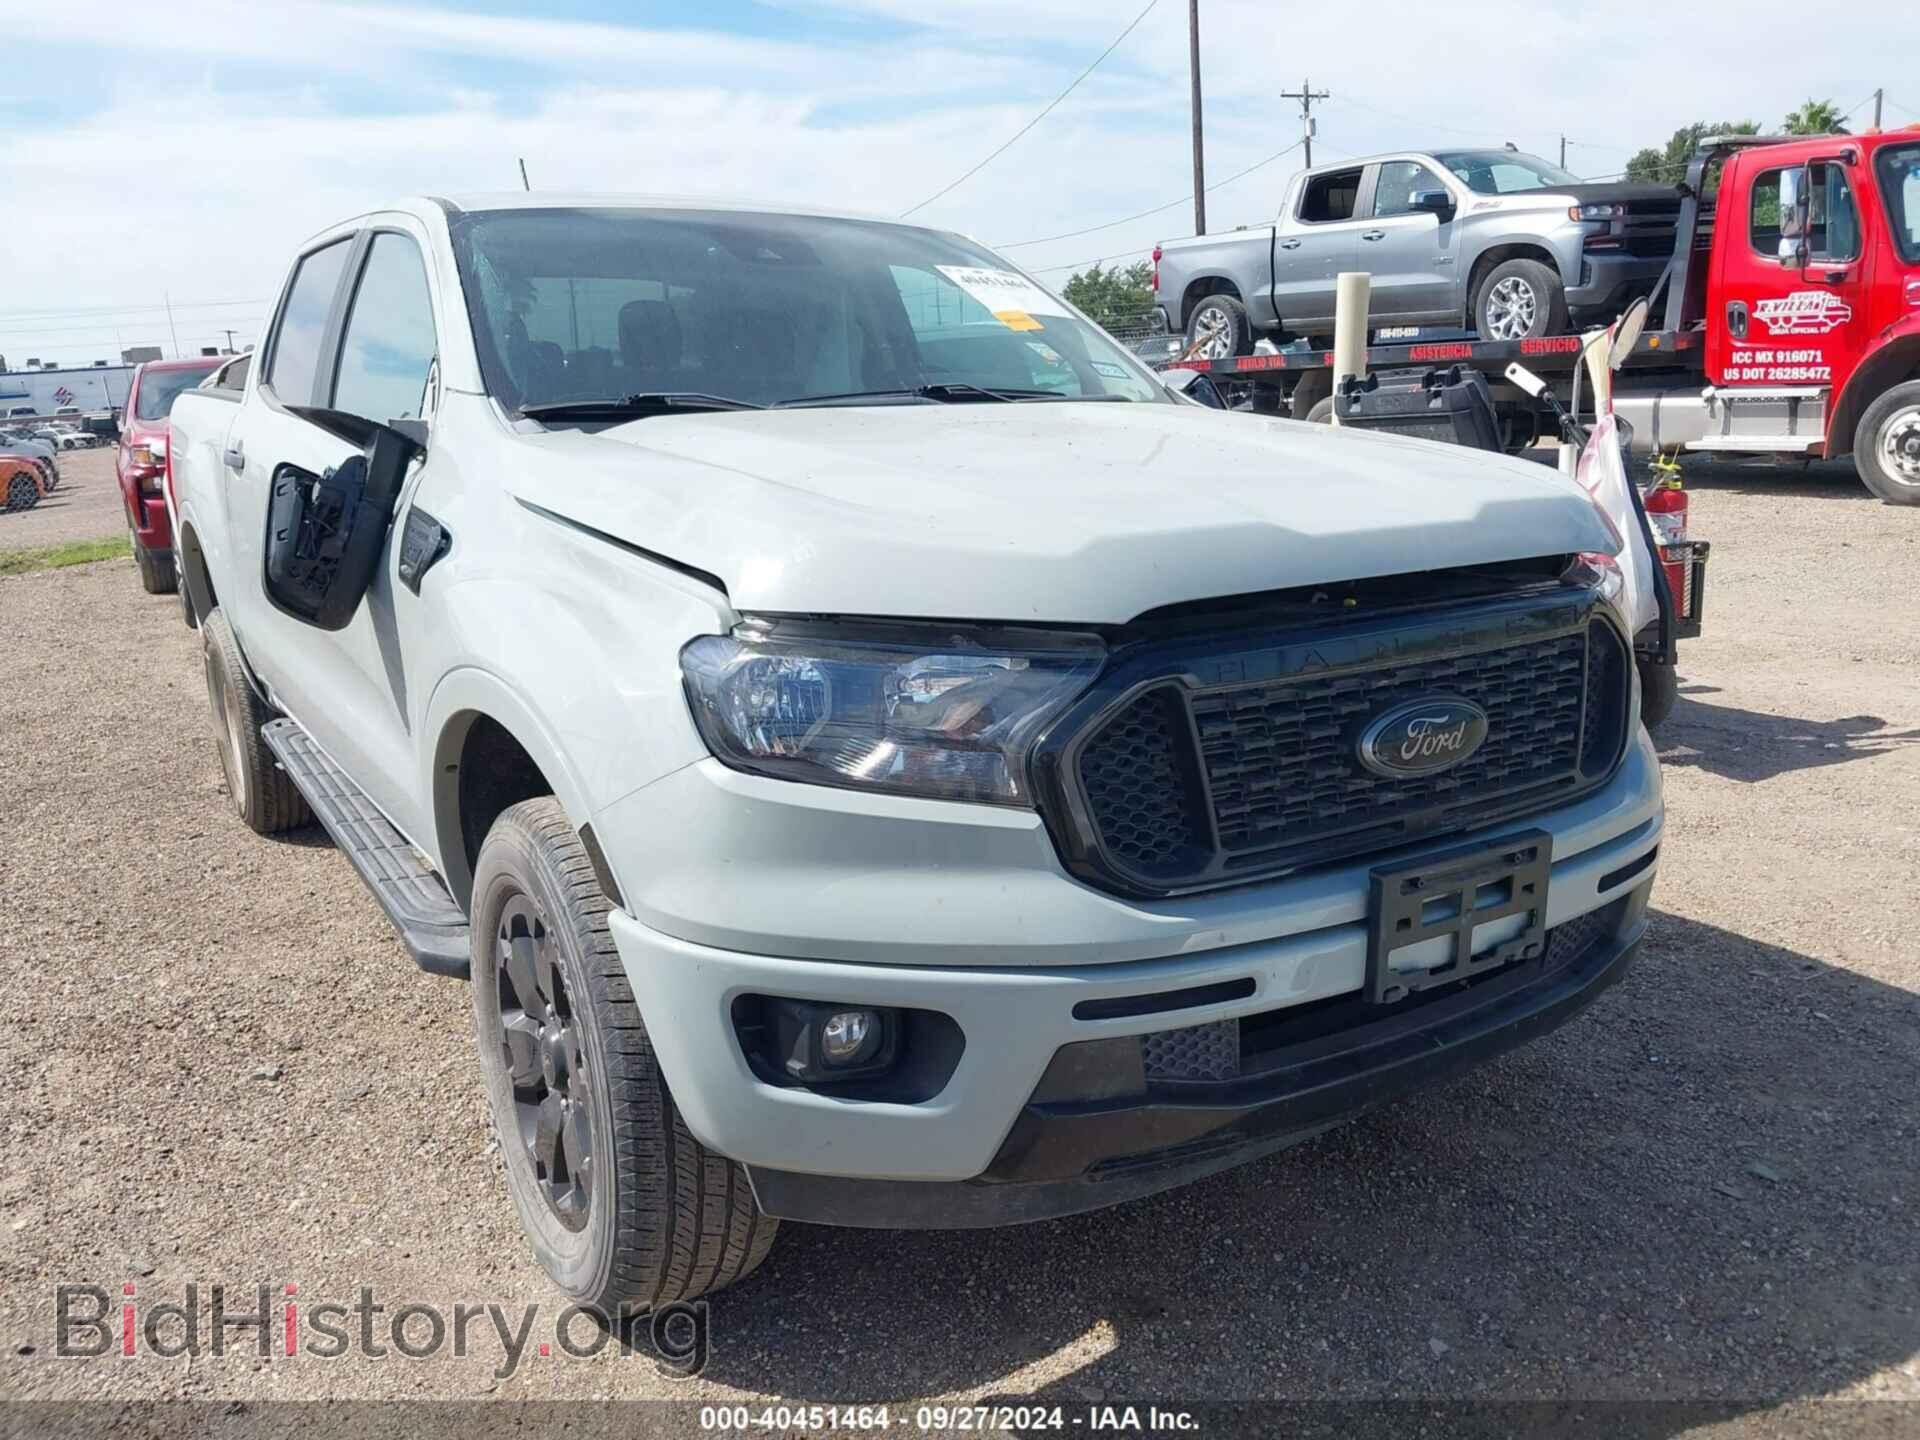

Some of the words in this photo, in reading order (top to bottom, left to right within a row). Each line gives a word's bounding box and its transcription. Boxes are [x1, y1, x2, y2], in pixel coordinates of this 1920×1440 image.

[1409, 344, 1473, 361] ASISTENCIA
[1520, 338, 1579, 354] SERVICIO
[1732, 352, 1752, 364] ICC
[1755, 351, 1774, 363] MX
[1776, 350, 1823, 363] 916071
[1723, 368, 1740, 380] US
[1742, 367, 1766, 380] DOT
[1401, 714, 1466, 760] Ford
